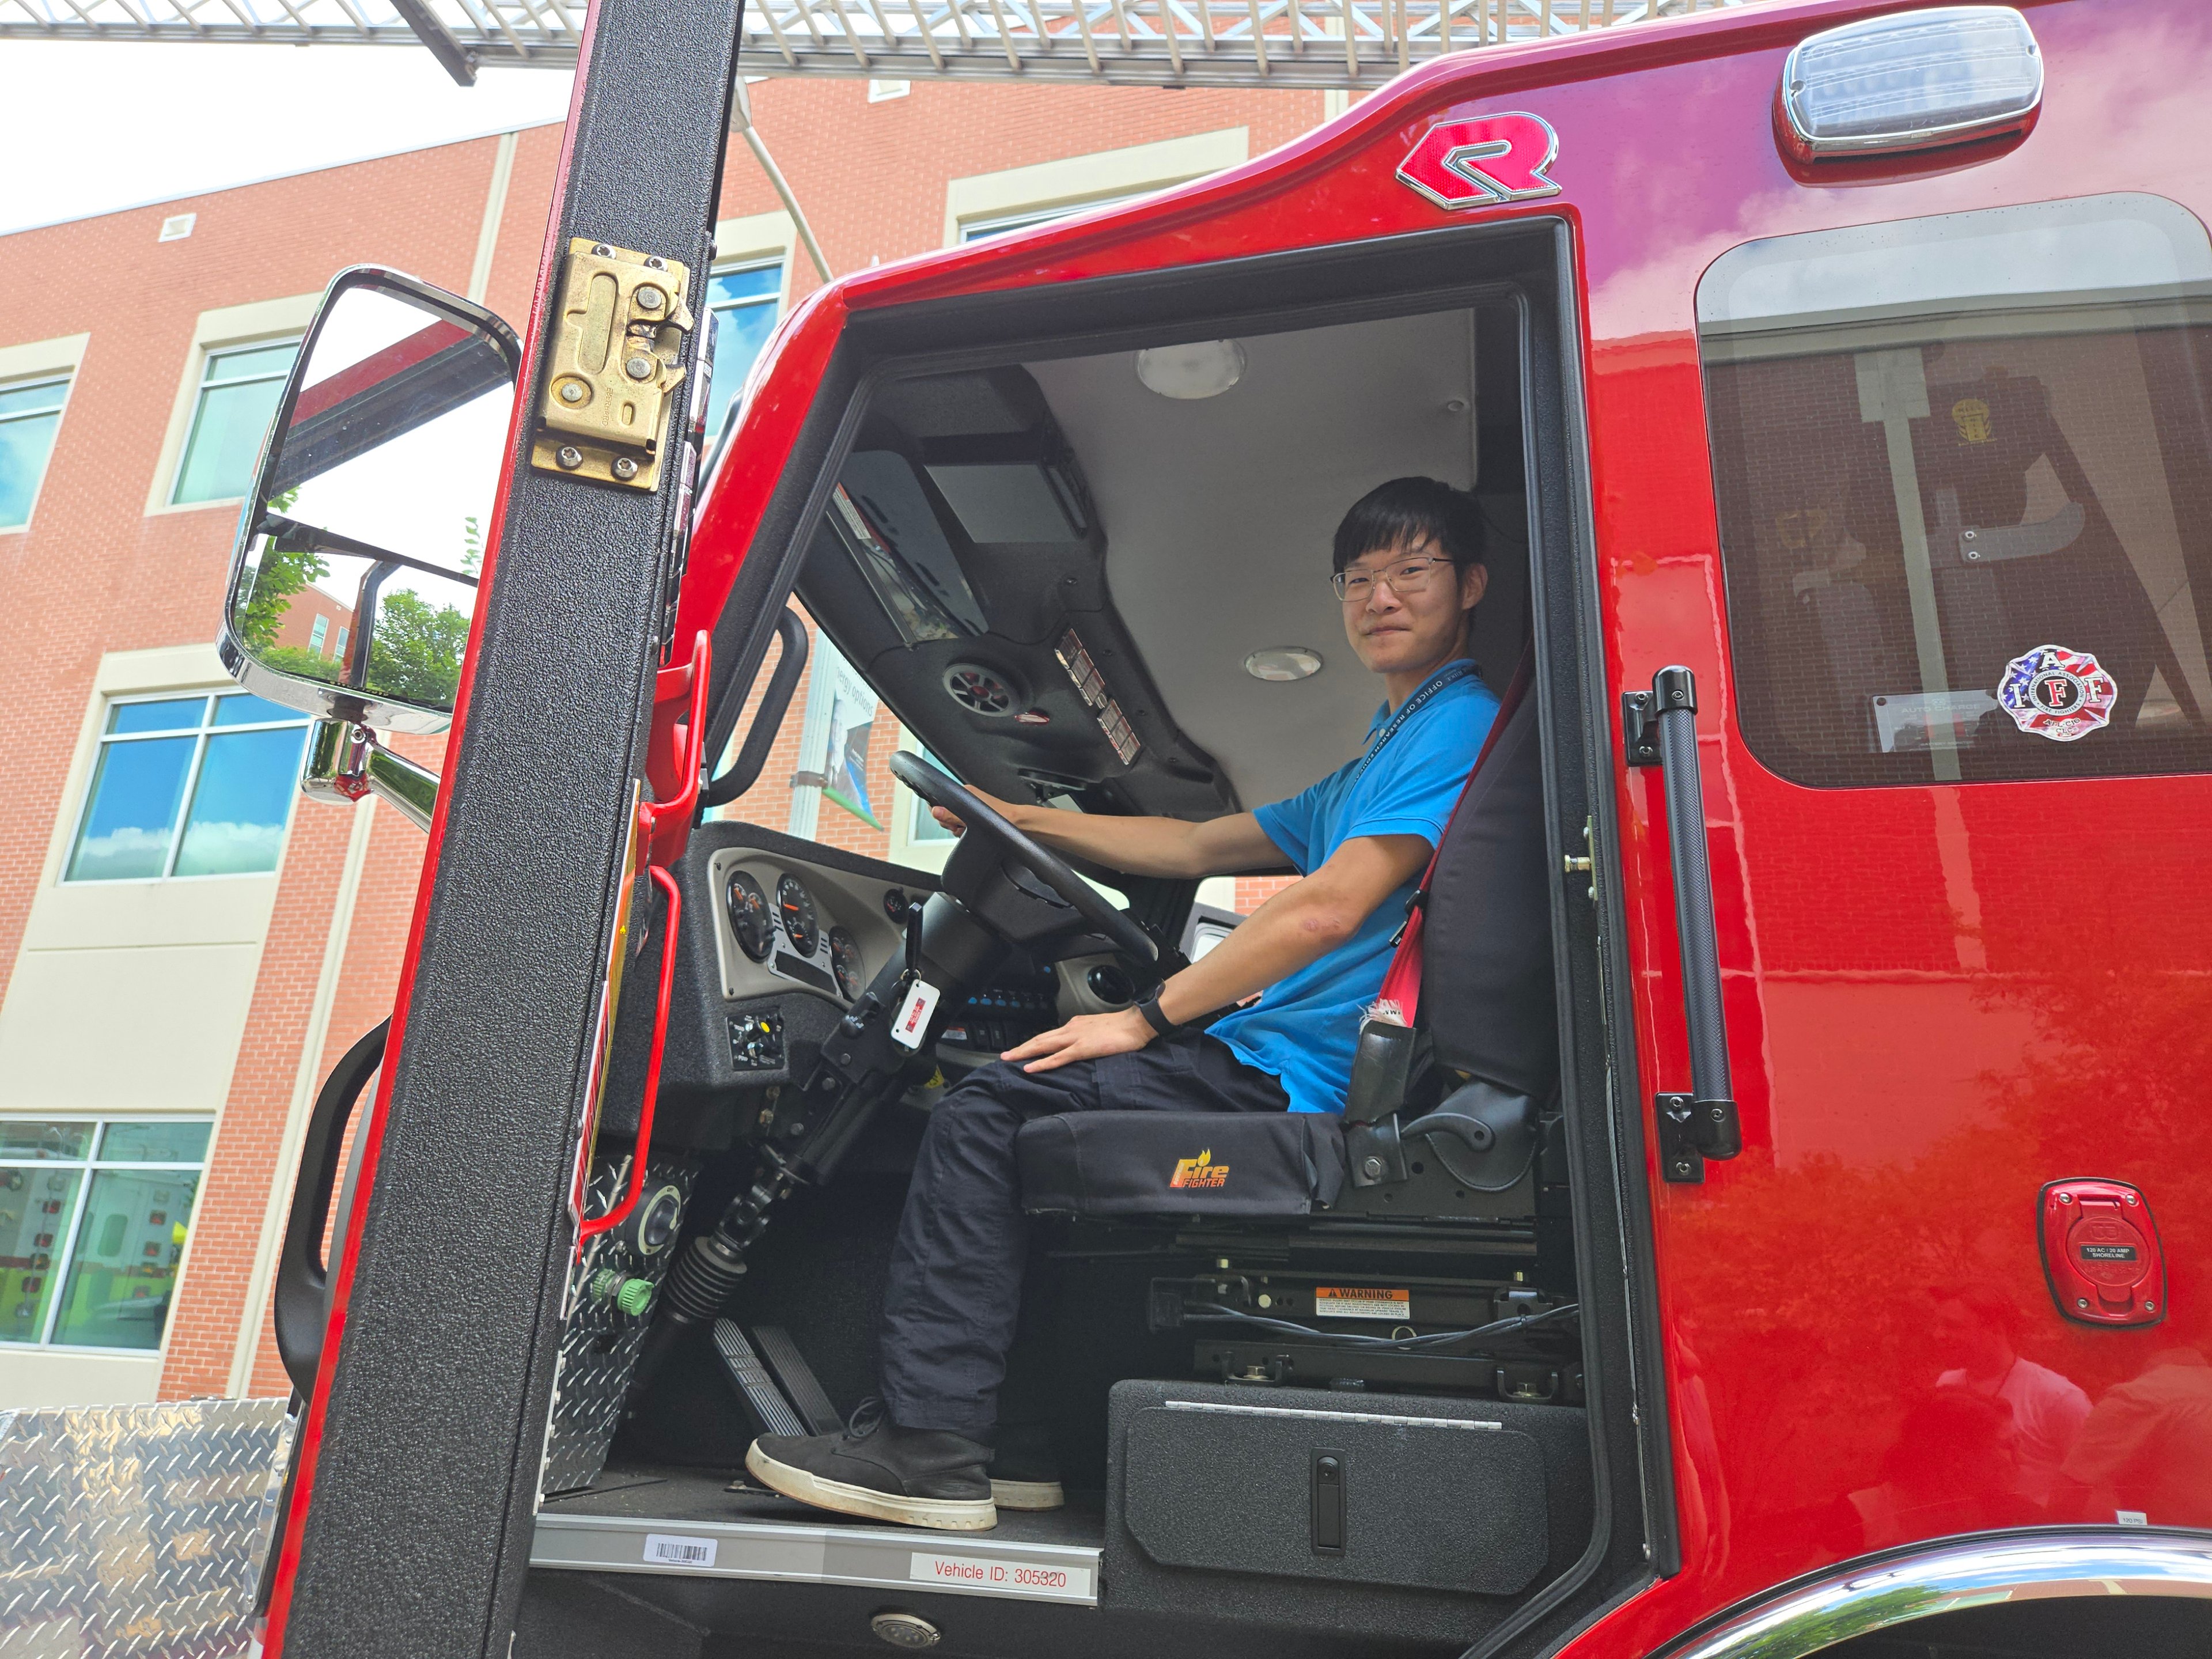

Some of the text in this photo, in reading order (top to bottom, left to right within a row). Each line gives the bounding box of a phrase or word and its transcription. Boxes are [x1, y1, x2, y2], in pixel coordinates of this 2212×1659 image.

[1415, 680, 1443, 704] OFFICE
[2032, 672, 2085, 702] INTERNATIONAL ASSOCIATION
[851, 684, 874, 717] options
[1406, 703, 1416, 715] OF
[1934, 704, 1981, 712] CHARGE
[2040, 702, 2080, 714] FIRE FIGHTERS
[1374, 714, 1406, 752] RESEARCH
[1169, 1158, 1230, 1188] Fire
[1182, 1177, 1226, 1188] FIGHTER
[1339, 1289, 1393, 1299] WARNING
[935, 1560, 1066, 1588] Vehicle ID: 305320
